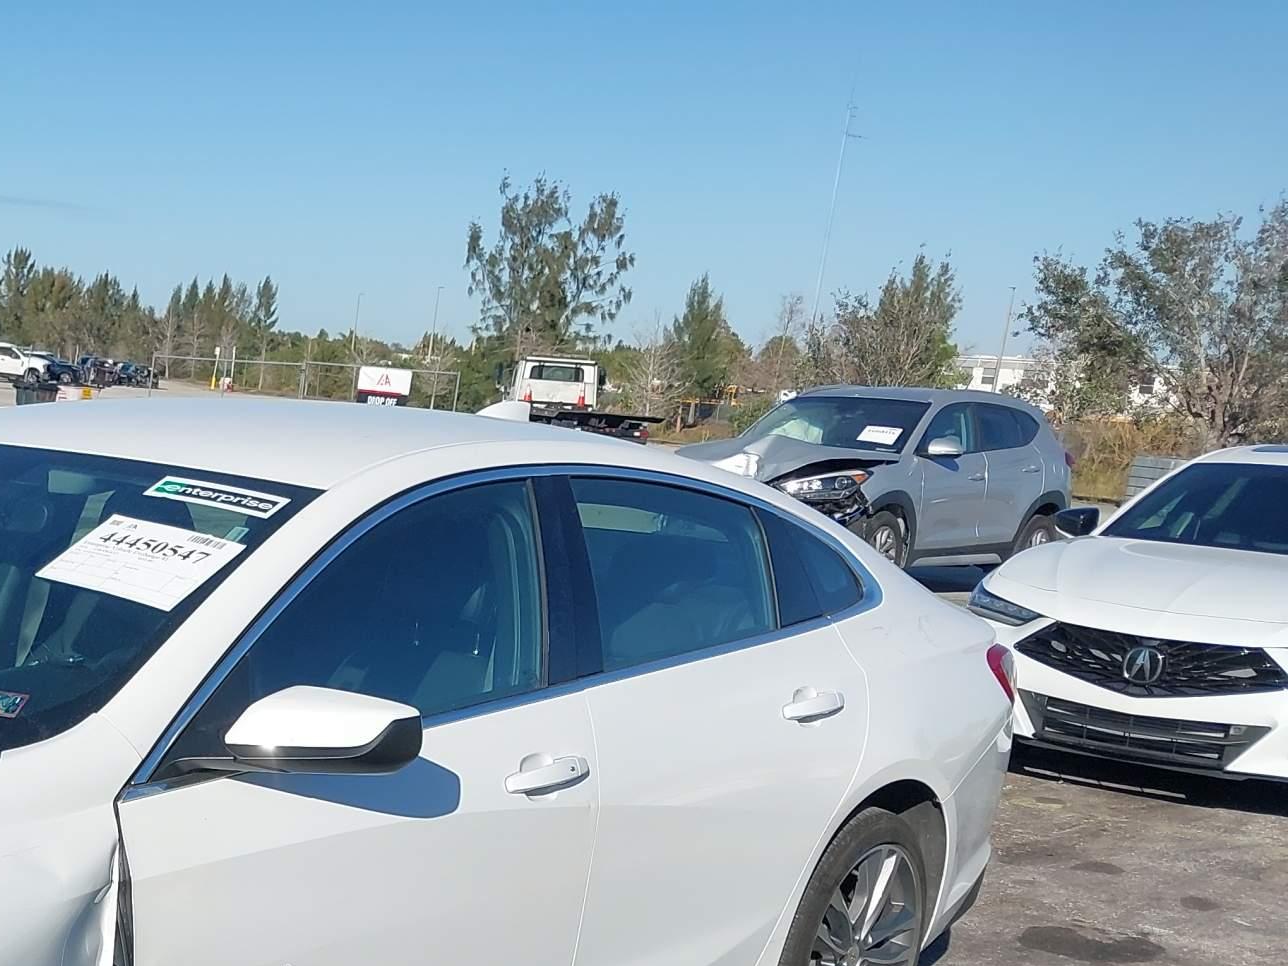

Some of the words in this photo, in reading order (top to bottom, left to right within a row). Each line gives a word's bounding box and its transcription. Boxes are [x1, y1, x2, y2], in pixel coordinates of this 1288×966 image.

[367, 395, 385, 406] DROP
[162, 483, 274, 511] enterprise
[99, 531, 212, 564] 44450547
